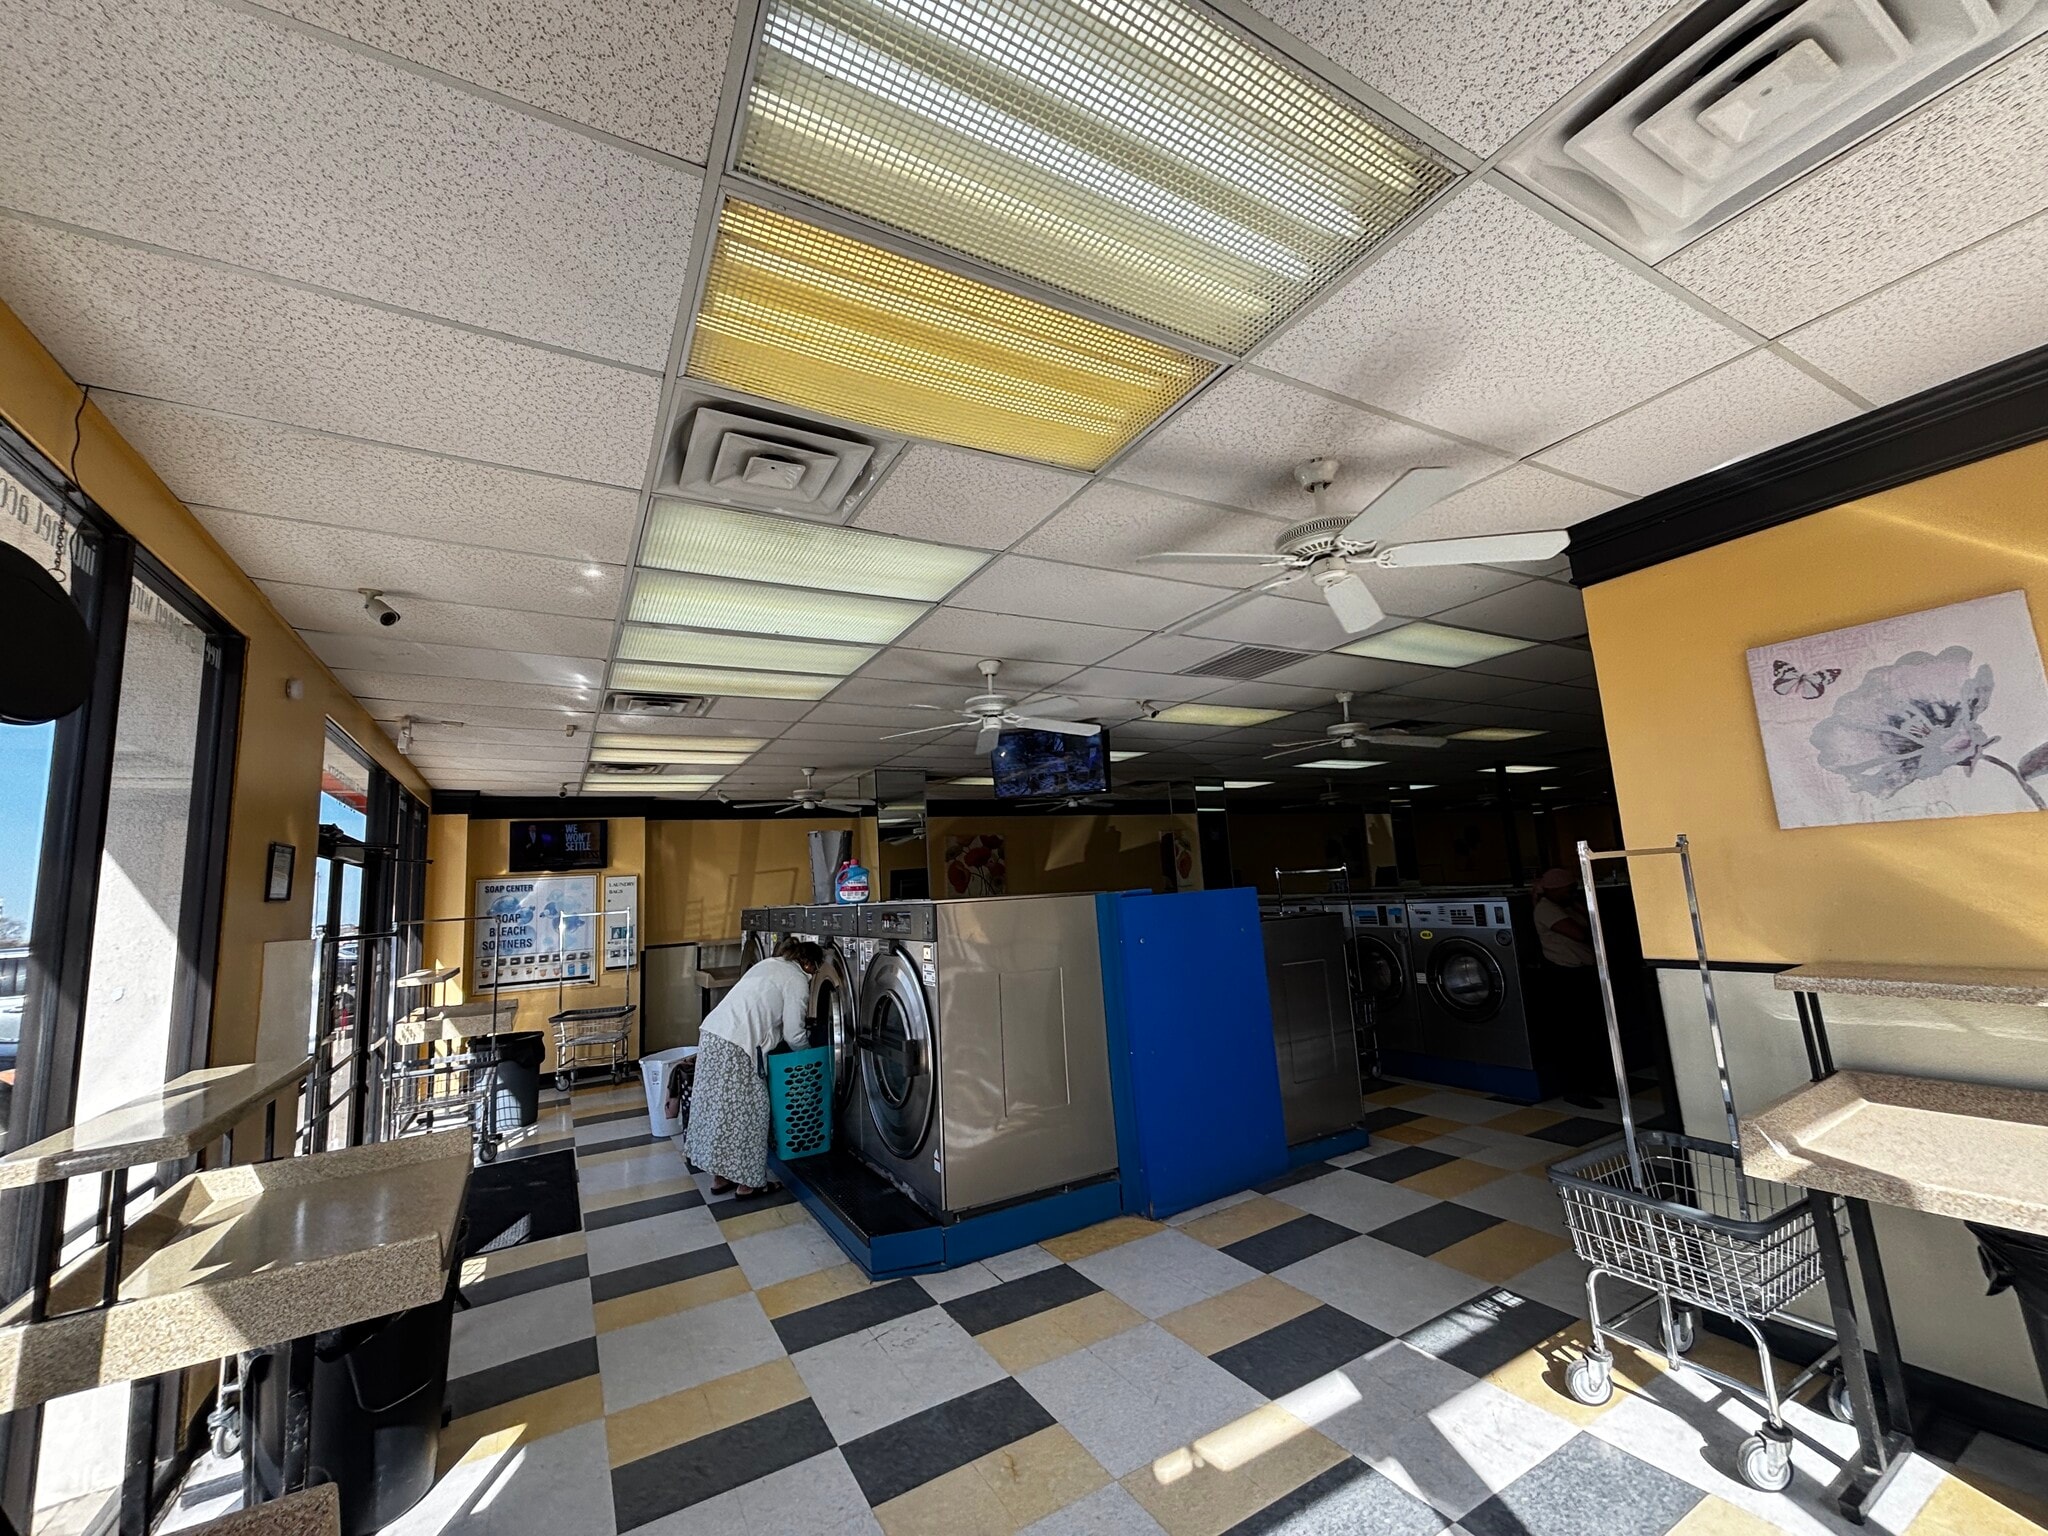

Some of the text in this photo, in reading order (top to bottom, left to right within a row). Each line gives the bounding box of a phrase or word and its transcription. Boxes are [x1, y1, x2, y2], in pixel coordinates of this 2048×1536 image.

[565, 823, 578, 833] WE
[565, 832, 591, 842] WON'T
[565, 841, 591, 851] SETTLE
[484, 884, 534, 894] SOAP CENTER
